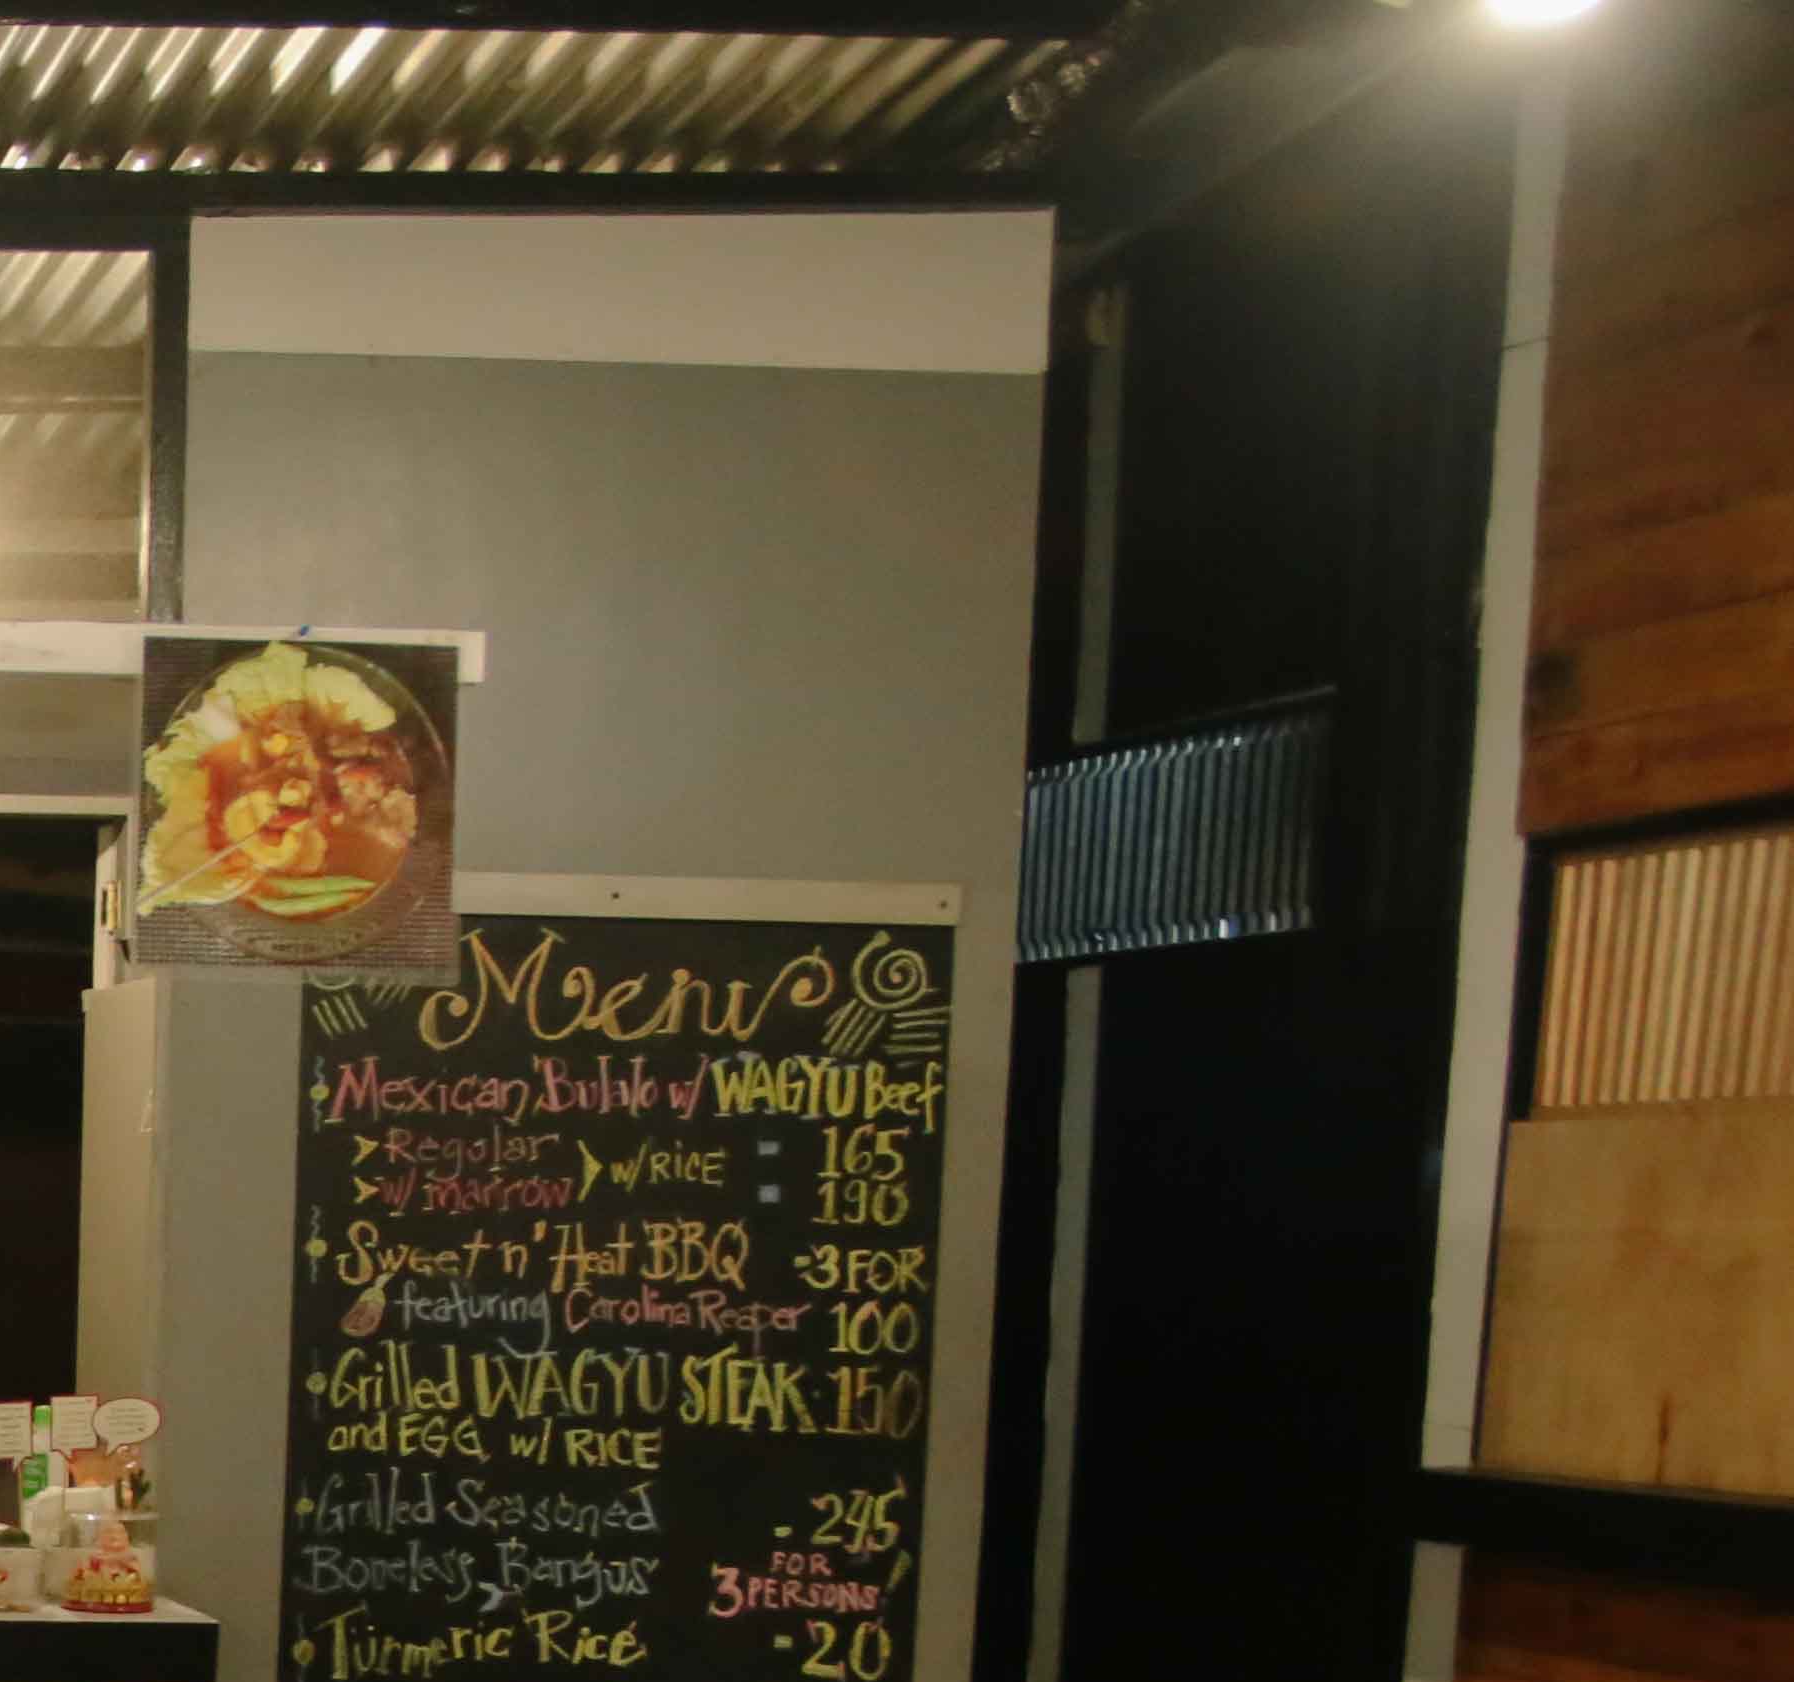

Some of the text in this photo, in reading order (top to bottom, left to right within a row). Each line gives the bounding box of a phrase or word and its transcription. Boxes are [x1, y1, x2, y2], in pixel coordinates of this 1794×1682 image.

[419, 928, 835, 1051] Menu
[325, 1056, 529, 1125] Mexican
[713, 1055, 860, 1119] WAGYU
[863, 1060, 943, 1134] Beef
[385, 1124, 911, 1182] Regular 165
[421, 1175, 574, 1216] marrow
[335, 1220, 492, 1286] Sweet
[640, 1217, 750, 1292] BBQ
[842, 1246, 928, 1294] FOR
[394, 1279, 921, 1360] featuring Carolina Reaper 100
[328, 1339, 923, 1440] Grilled WAGYU STEAK 150
[327, 1411, 388, 1452] and
[397, 1413, 493, 1464] EGG
[564, 1426, 662, 1470] RICE
[444, 1477, 662, 1537] Seasoned
[746, 1577, 881, 1613] PERSONS
[771, 1551, 833, 1577] FOR
[316, 1602, 893, 1682] Turmeric Rice 20
